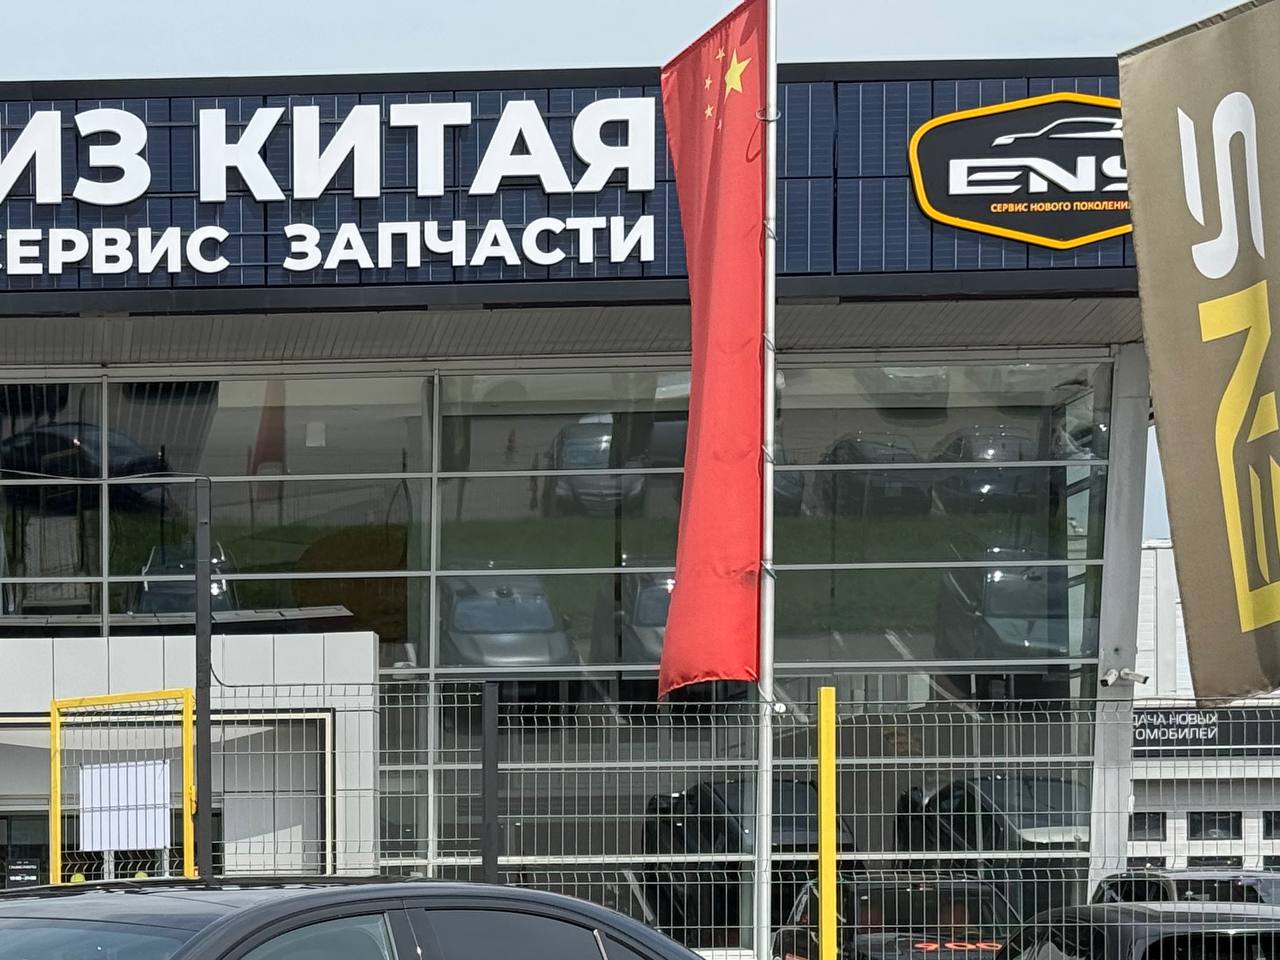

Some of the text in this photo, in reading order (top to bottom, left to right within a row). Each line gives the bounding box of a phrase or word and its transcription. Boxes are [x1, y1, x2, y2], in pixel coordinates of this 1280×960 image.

[199, 97, 656, 203] КИТАЯ
[990, 200, 1132, 213] СЕРВИС НОВОГО ПОКОЛЕНИ
[282, 215, 655, 272] ЗАПЧАСТИ
[1169, 713, 1218, 725] НОВЫХ
[1133, 727, 1218, 740] ОМОБИЛЕЙ
